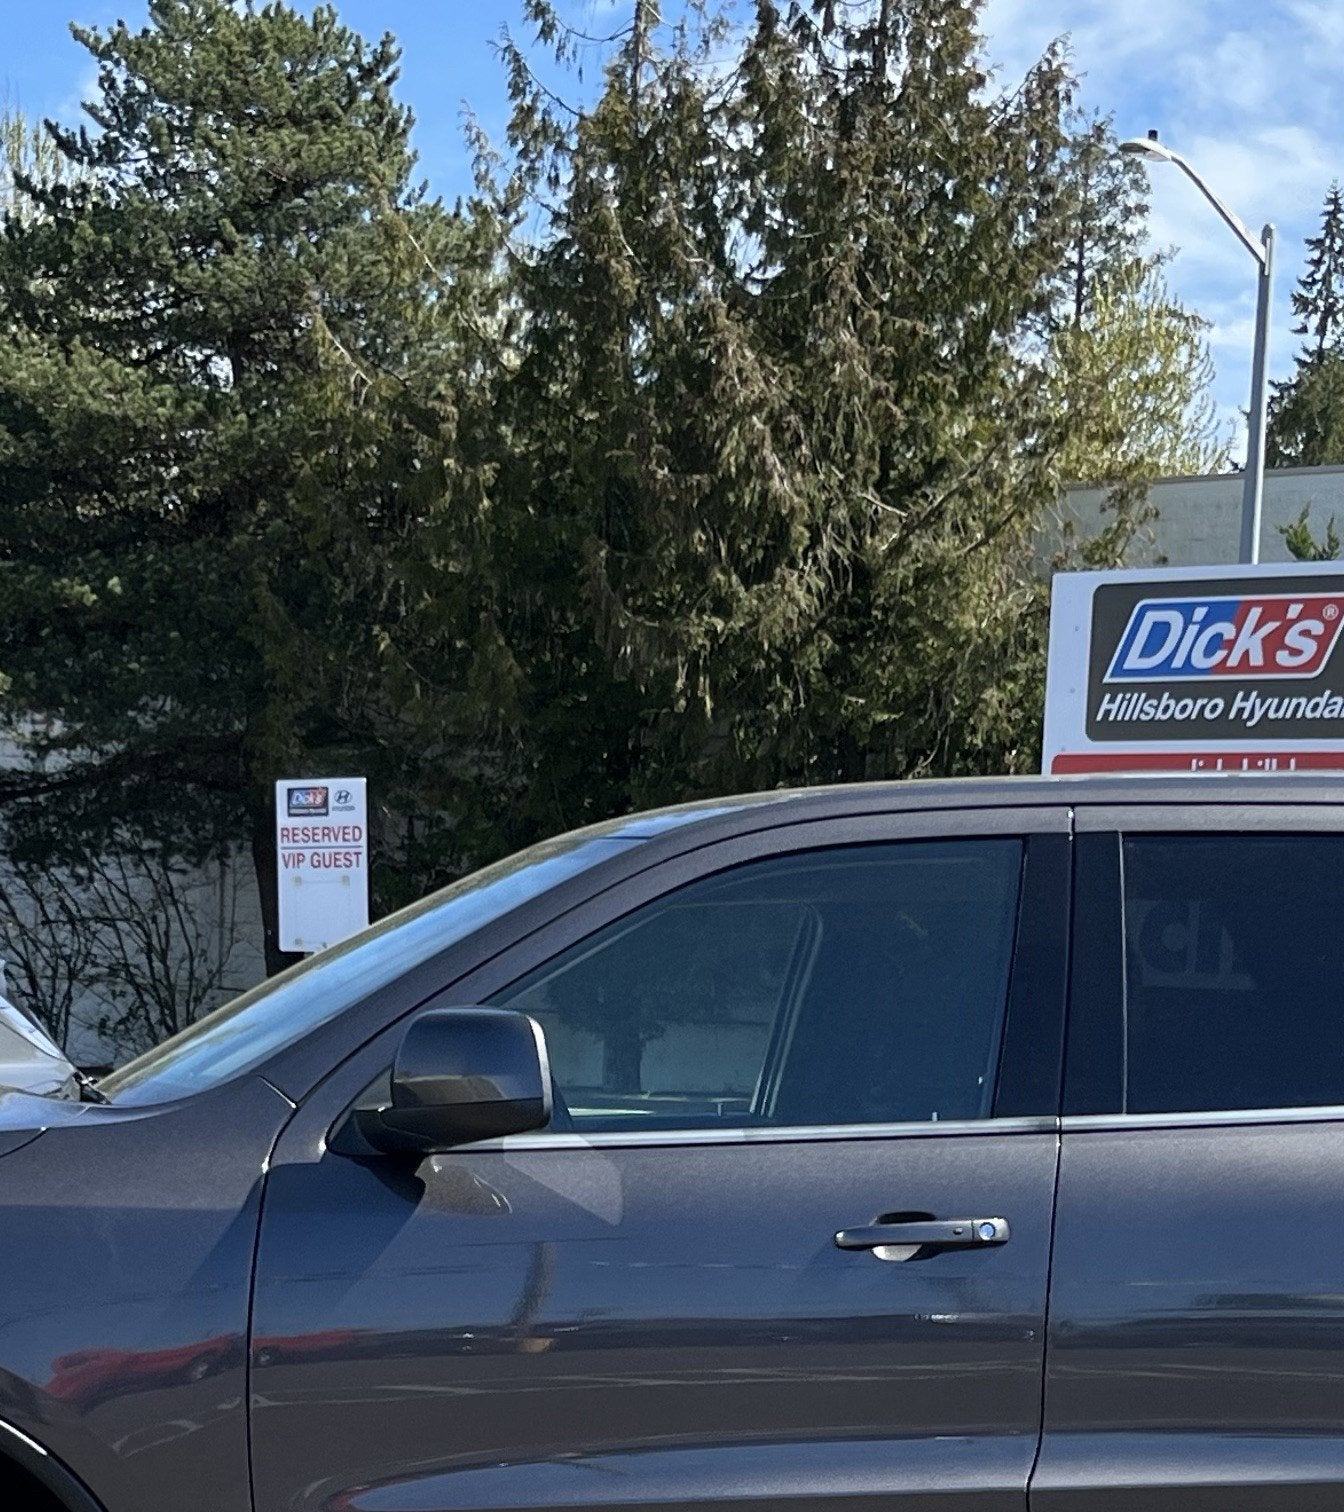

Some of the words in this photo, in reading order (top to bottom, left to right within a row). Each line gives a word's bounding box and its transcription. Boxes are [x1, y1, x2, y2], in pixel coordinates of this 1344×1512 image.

[1122, 603, 1325, 670] Dick's
[1095, 692, 1225, 722] Hillsboro
[280, 825, 363, 844] RESERVED
[281, 852, 305, 869] VIP
[310, 851, 363, 869] GUEST
